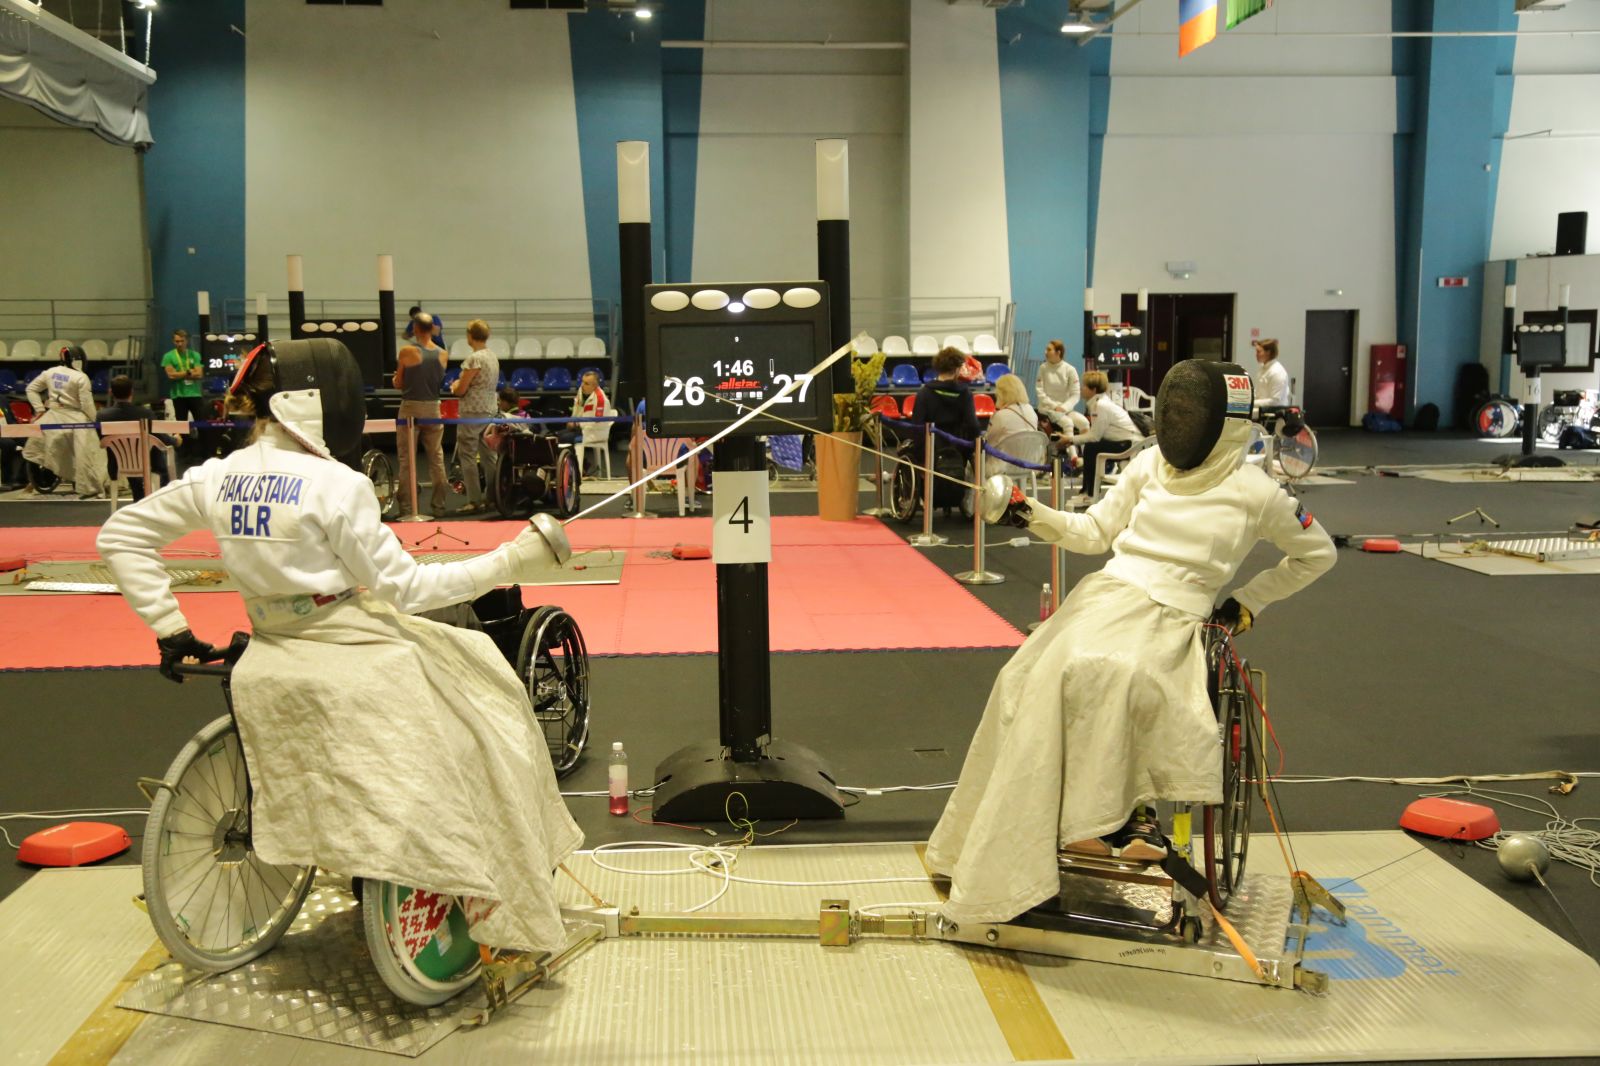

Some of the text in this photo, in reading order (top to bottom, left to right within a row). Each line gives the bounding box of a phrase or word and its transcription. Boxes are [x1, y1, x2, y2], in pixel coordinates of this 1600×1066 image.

[1098, 352, 1105, 362] 4
[1128, 351, 1140, 362] 10
[209, 359, 223, 368] 20
[713, 359, 754, 377] 1:46
[720, 377, 758, 390] allstar
[773, 373, 814, 403] 27
[1228, 377, 1249, 390] 3M
[663, 376, 706, 406] 26
[735, 403, 743, 415] 7
[652, 424, 659, 433] 6
[216, 474, 303, 506] FIAKLISTAVA
[231, 504, 271, 537] BLR
[728, 496, 754, 533] 4
